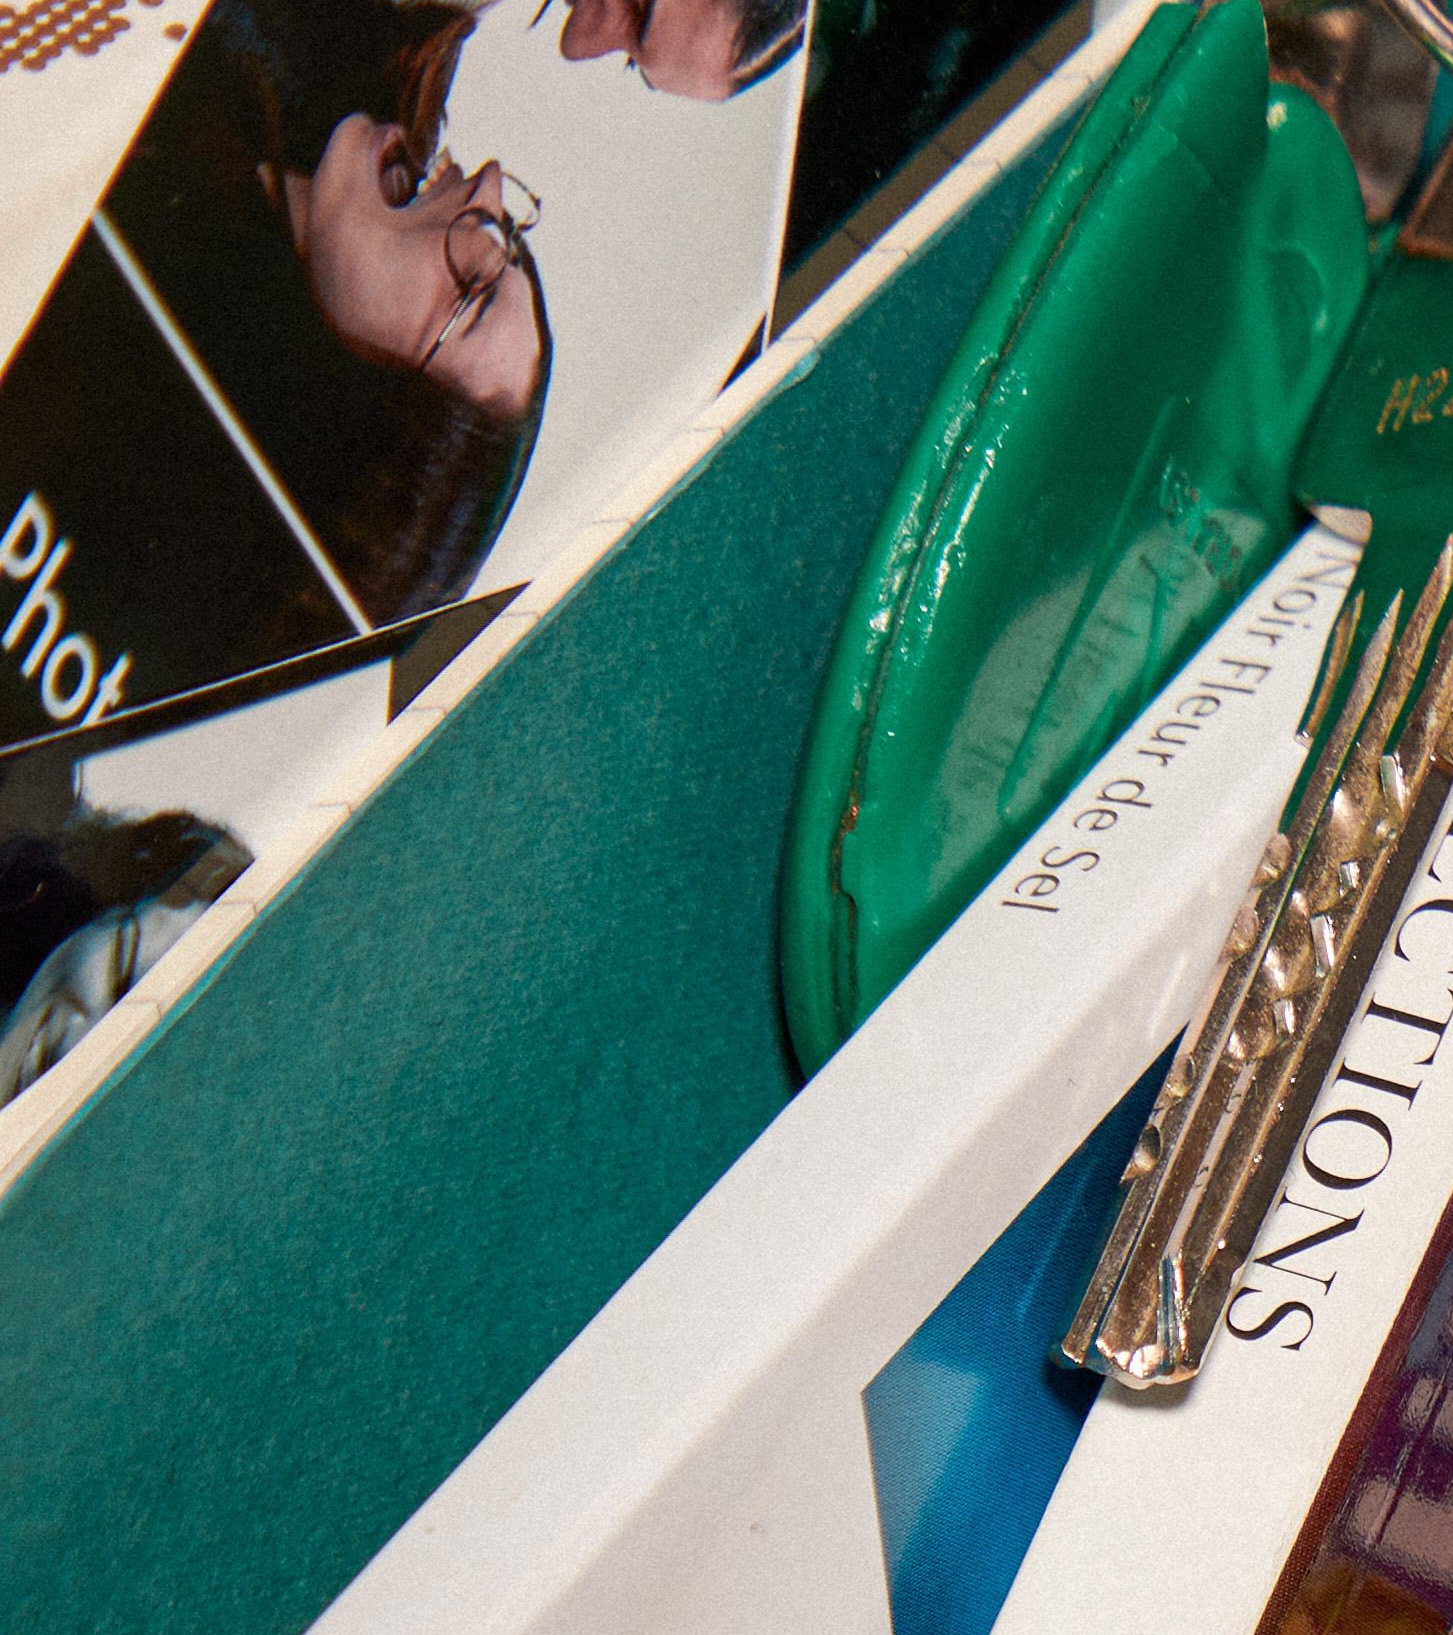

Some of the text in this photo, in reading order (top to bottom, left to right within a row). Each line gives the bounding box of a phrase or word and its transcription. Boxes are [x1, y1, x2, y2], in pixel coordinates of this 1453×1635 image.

[1245, 552, 1359, 649] Noir
[1137, 656, 1272, 768] Fleur
[1073, 777, 1153, 833] de
[1000, 845, 1101, 915] Sel
